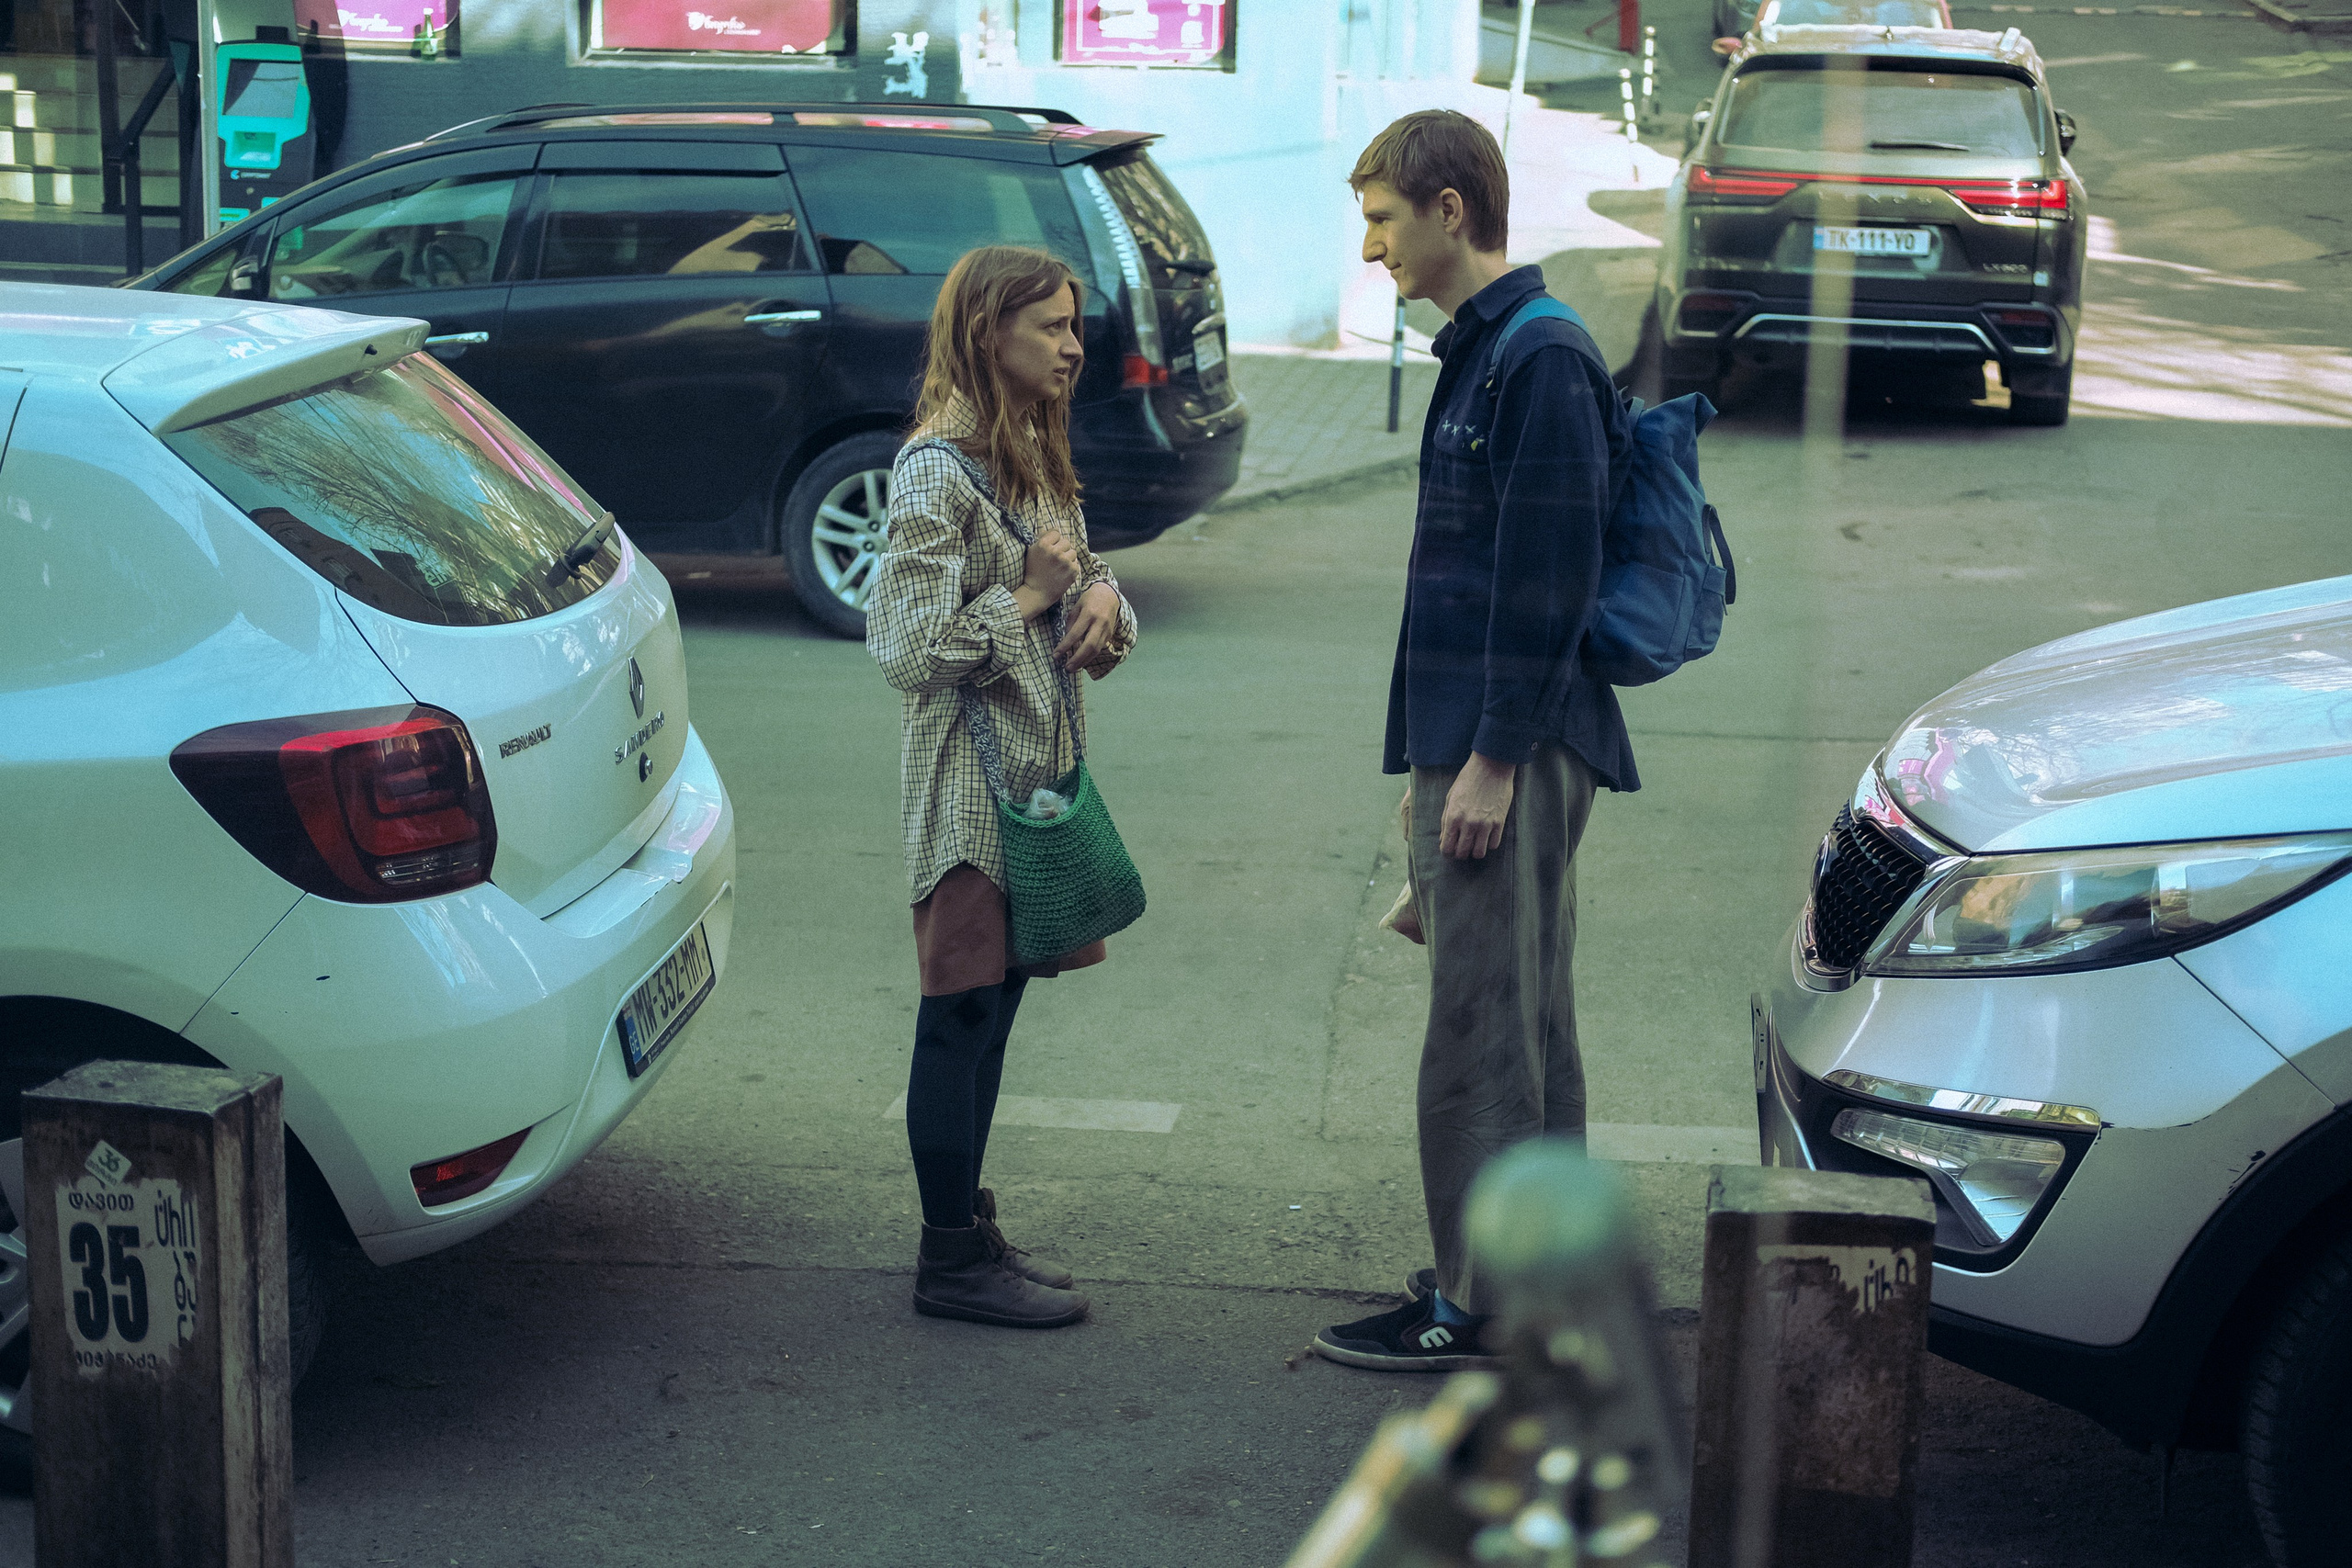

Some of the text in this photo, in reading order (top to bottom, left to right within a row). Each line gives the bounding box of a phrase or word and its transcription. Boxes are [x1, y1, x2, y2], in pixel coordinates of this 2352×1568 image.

[498, 723, 552, 760] RENAULT
[614, 710, 665, 766] SANDERO
[631, 932, 704, 1045] MW-332-MM
[68, 1222, 150, 1343] 35
